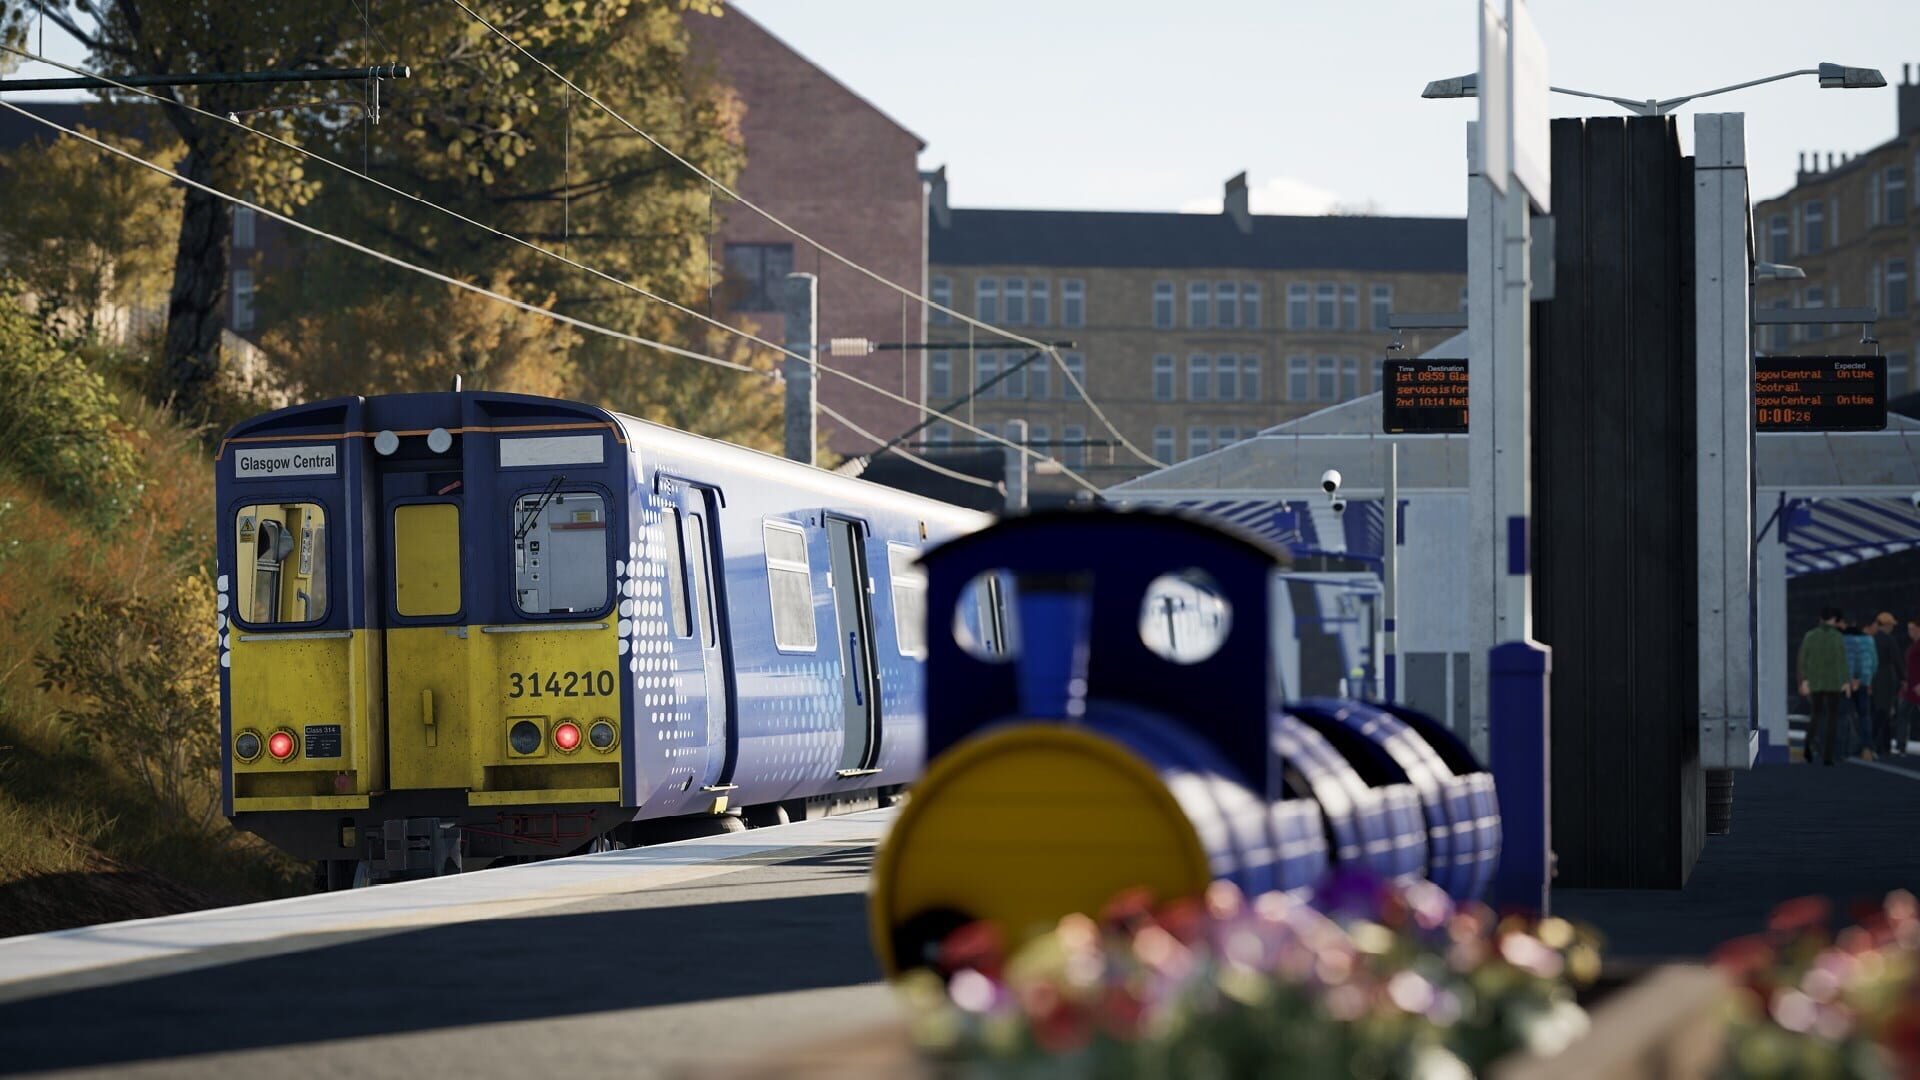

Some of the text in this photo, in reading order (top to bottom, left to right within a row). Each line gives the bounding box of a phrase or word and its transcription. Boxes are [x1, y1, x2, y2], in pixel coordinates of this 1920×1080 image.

[240, 453, 335, 473] Glasgow Central
[509, 670, 615, 698] 314210
